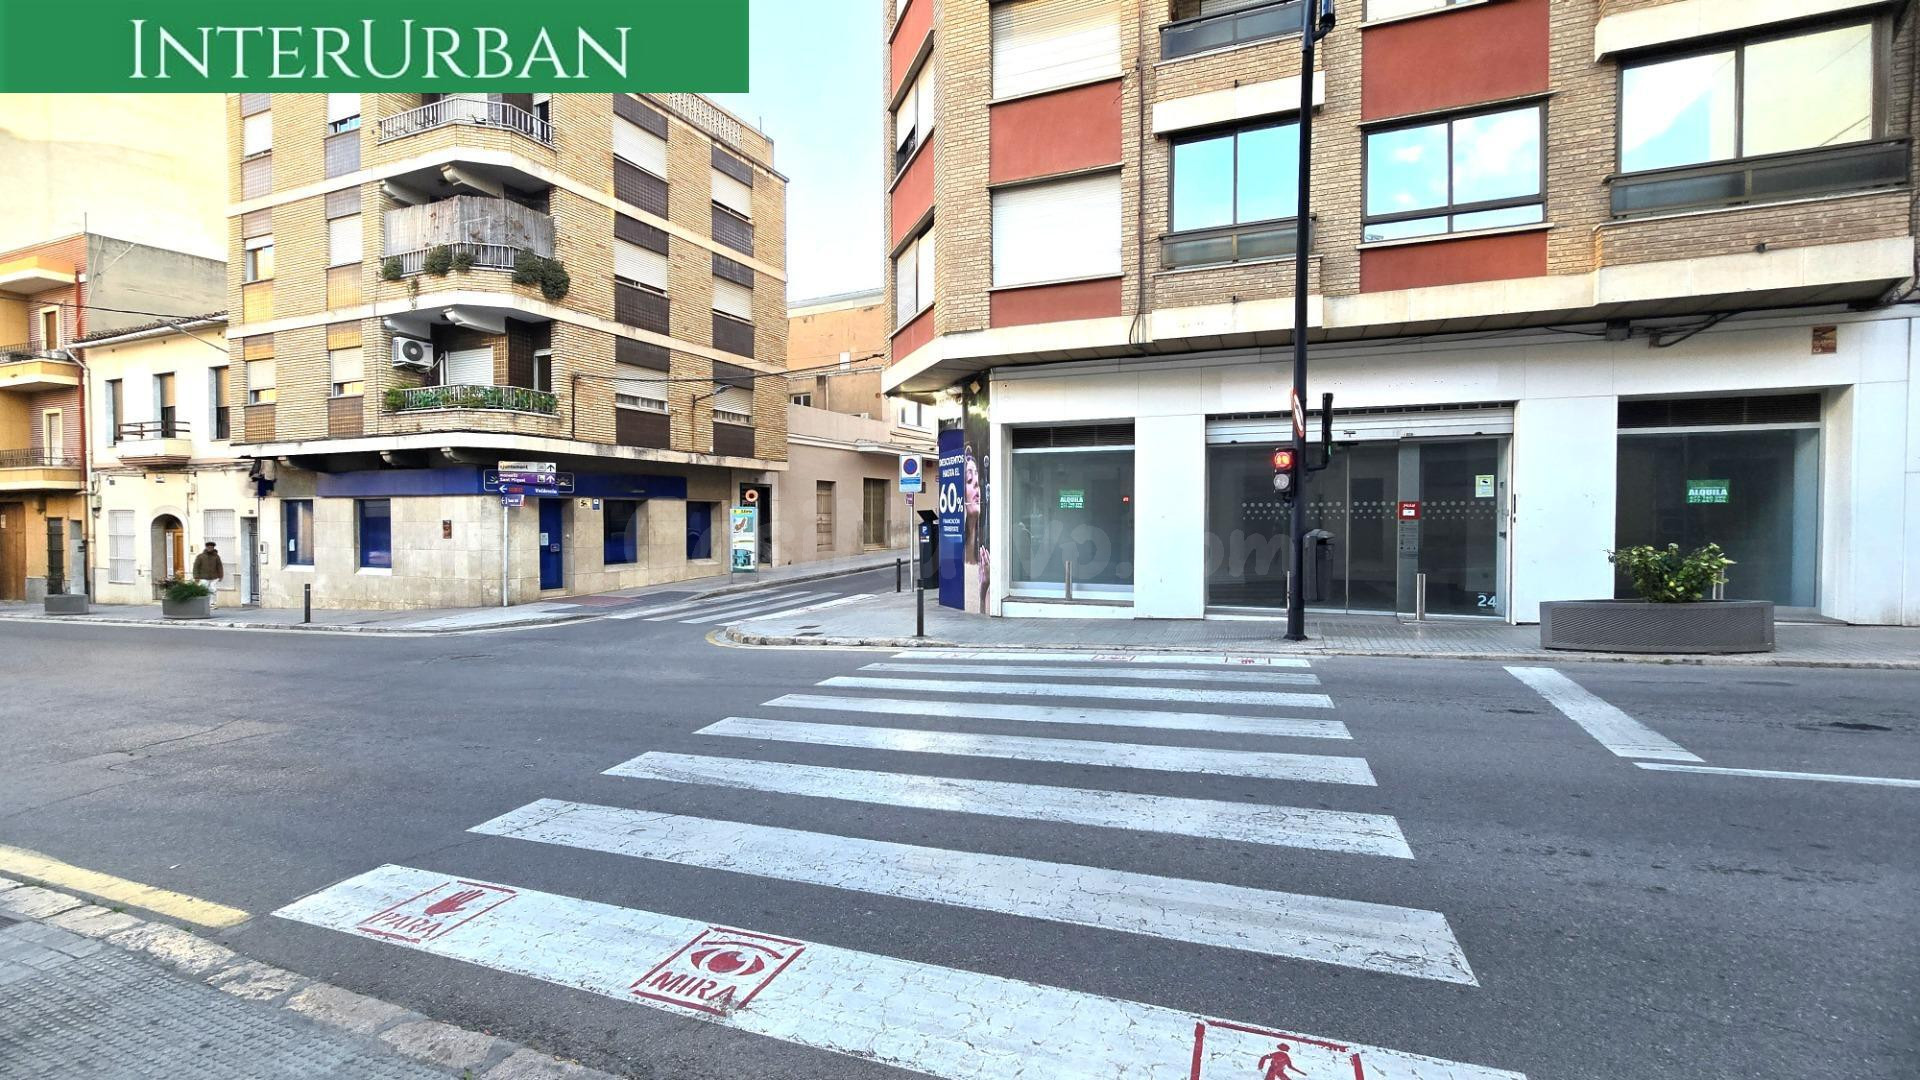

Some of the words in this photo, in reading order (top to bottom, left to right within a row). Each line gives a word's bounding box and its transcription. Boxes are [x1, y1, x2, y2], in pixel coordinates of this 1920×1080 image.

[939, 455, 964, 467] DESCUENTOS
[955, 467, 960, 476] EL
[940, 482, 963, 513] 60%
[1477, 595, 1497, 608] 24
[368, 912, 443, 938] PARA
[647, 971, 737, 1005] MIRA
